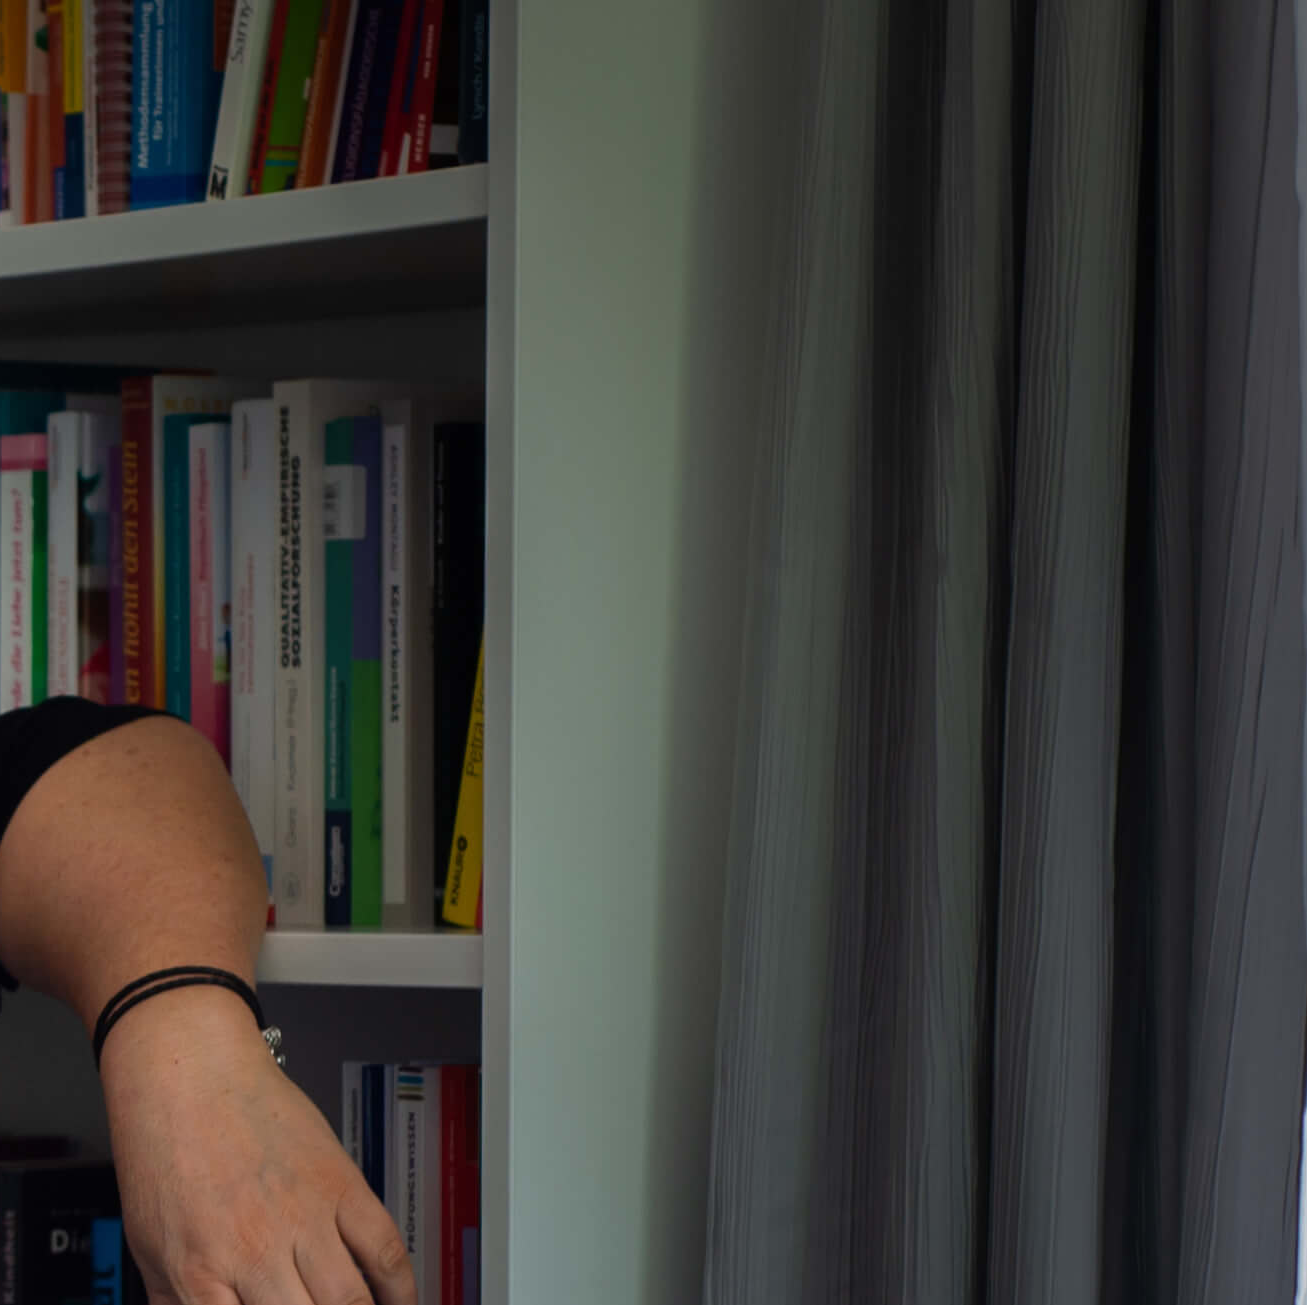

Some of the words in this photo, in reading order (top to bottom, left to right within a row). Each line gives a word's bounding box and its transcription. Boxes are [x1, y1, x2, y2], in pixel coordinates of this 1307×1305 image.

[138, 3, 153, 169] Methodensammlung
[122, 438, 139, 513] Stein
[290, 455, 302, 669] SOZIALFORSCHUNG
[388, 584, 401, 724] Körperkontakt
[0, 1209, 17, 1305] Kindheit
